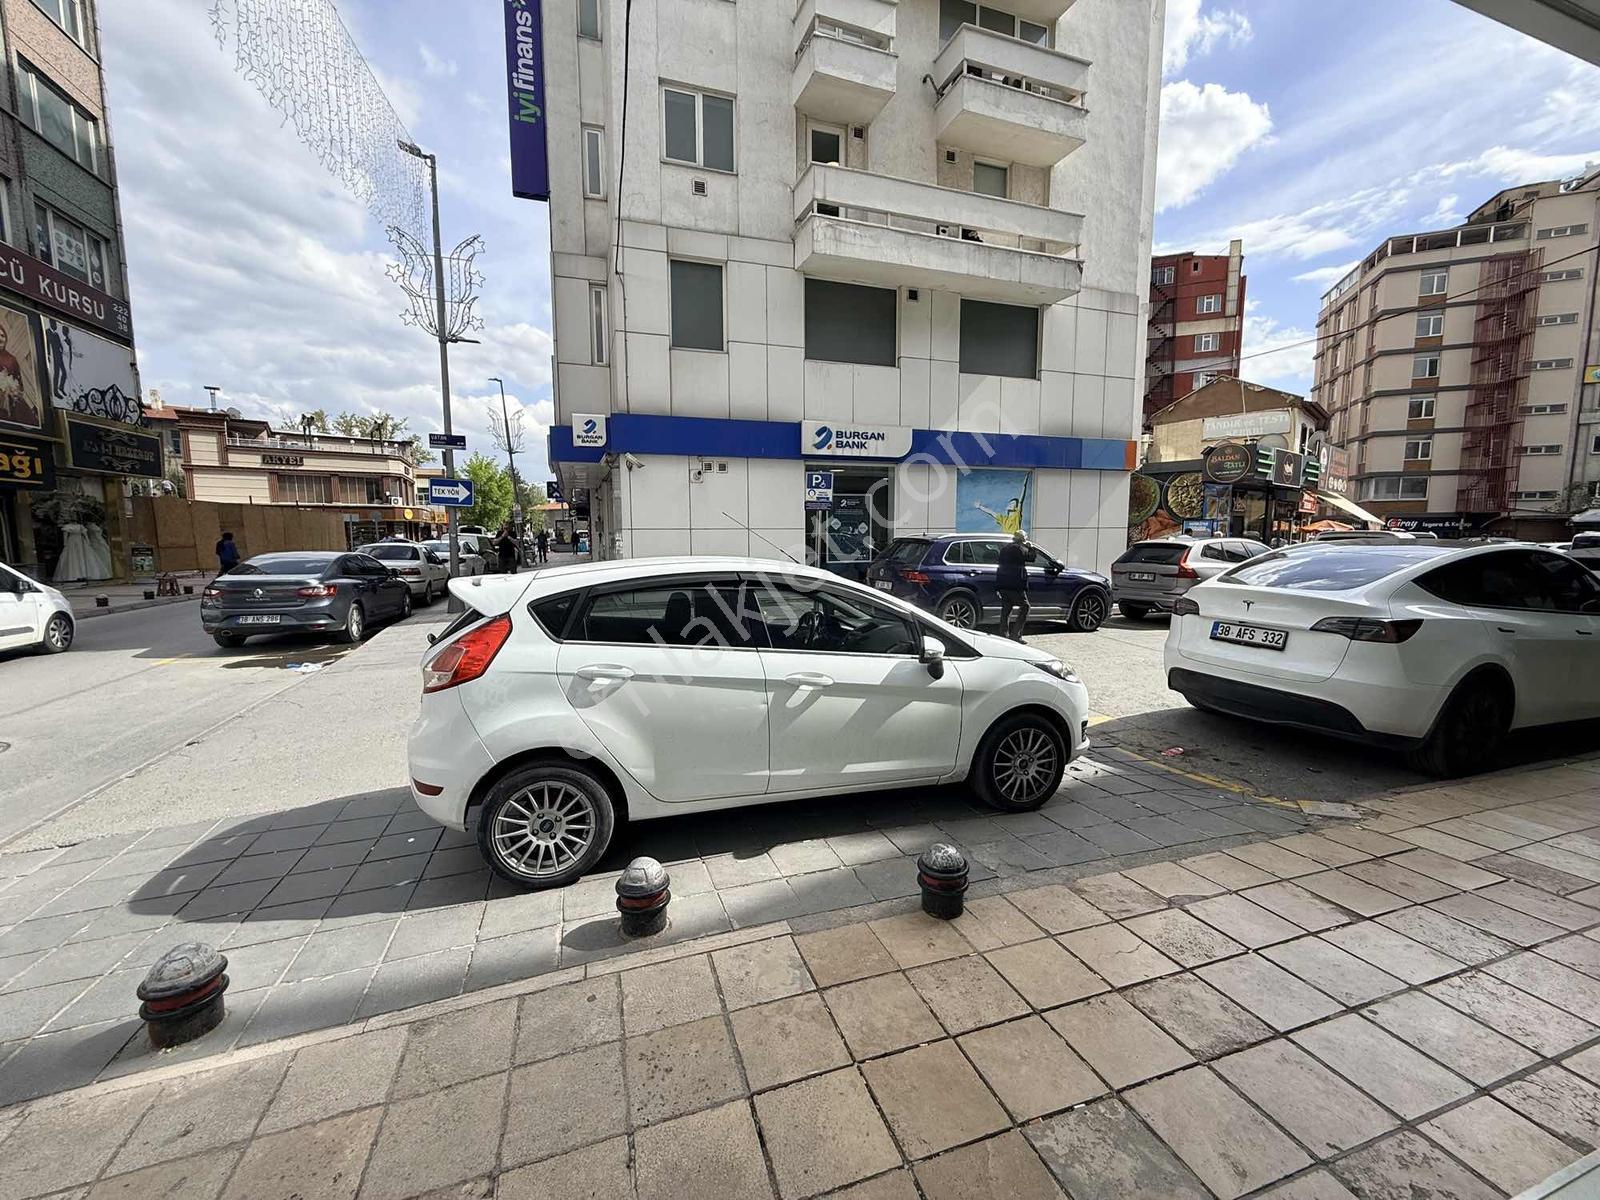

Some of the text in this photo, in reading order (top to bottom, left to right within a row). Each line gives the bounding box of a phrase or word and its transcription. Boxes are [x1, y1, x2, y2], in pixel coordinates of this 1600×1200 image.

[512, 10, 541, 123] iyifinans
[38, 275, 105, 319] KURSU
[112, 303, 129, 317] 222
[835, 431, 885, 441] BURGAN
[835, 440, 867, 449] BANK
[264, 454, 304, 465] AKYEL
[447, 488, 460, 496] YÖN
[1218, 625, 1283, 645] 38 AFS 332
